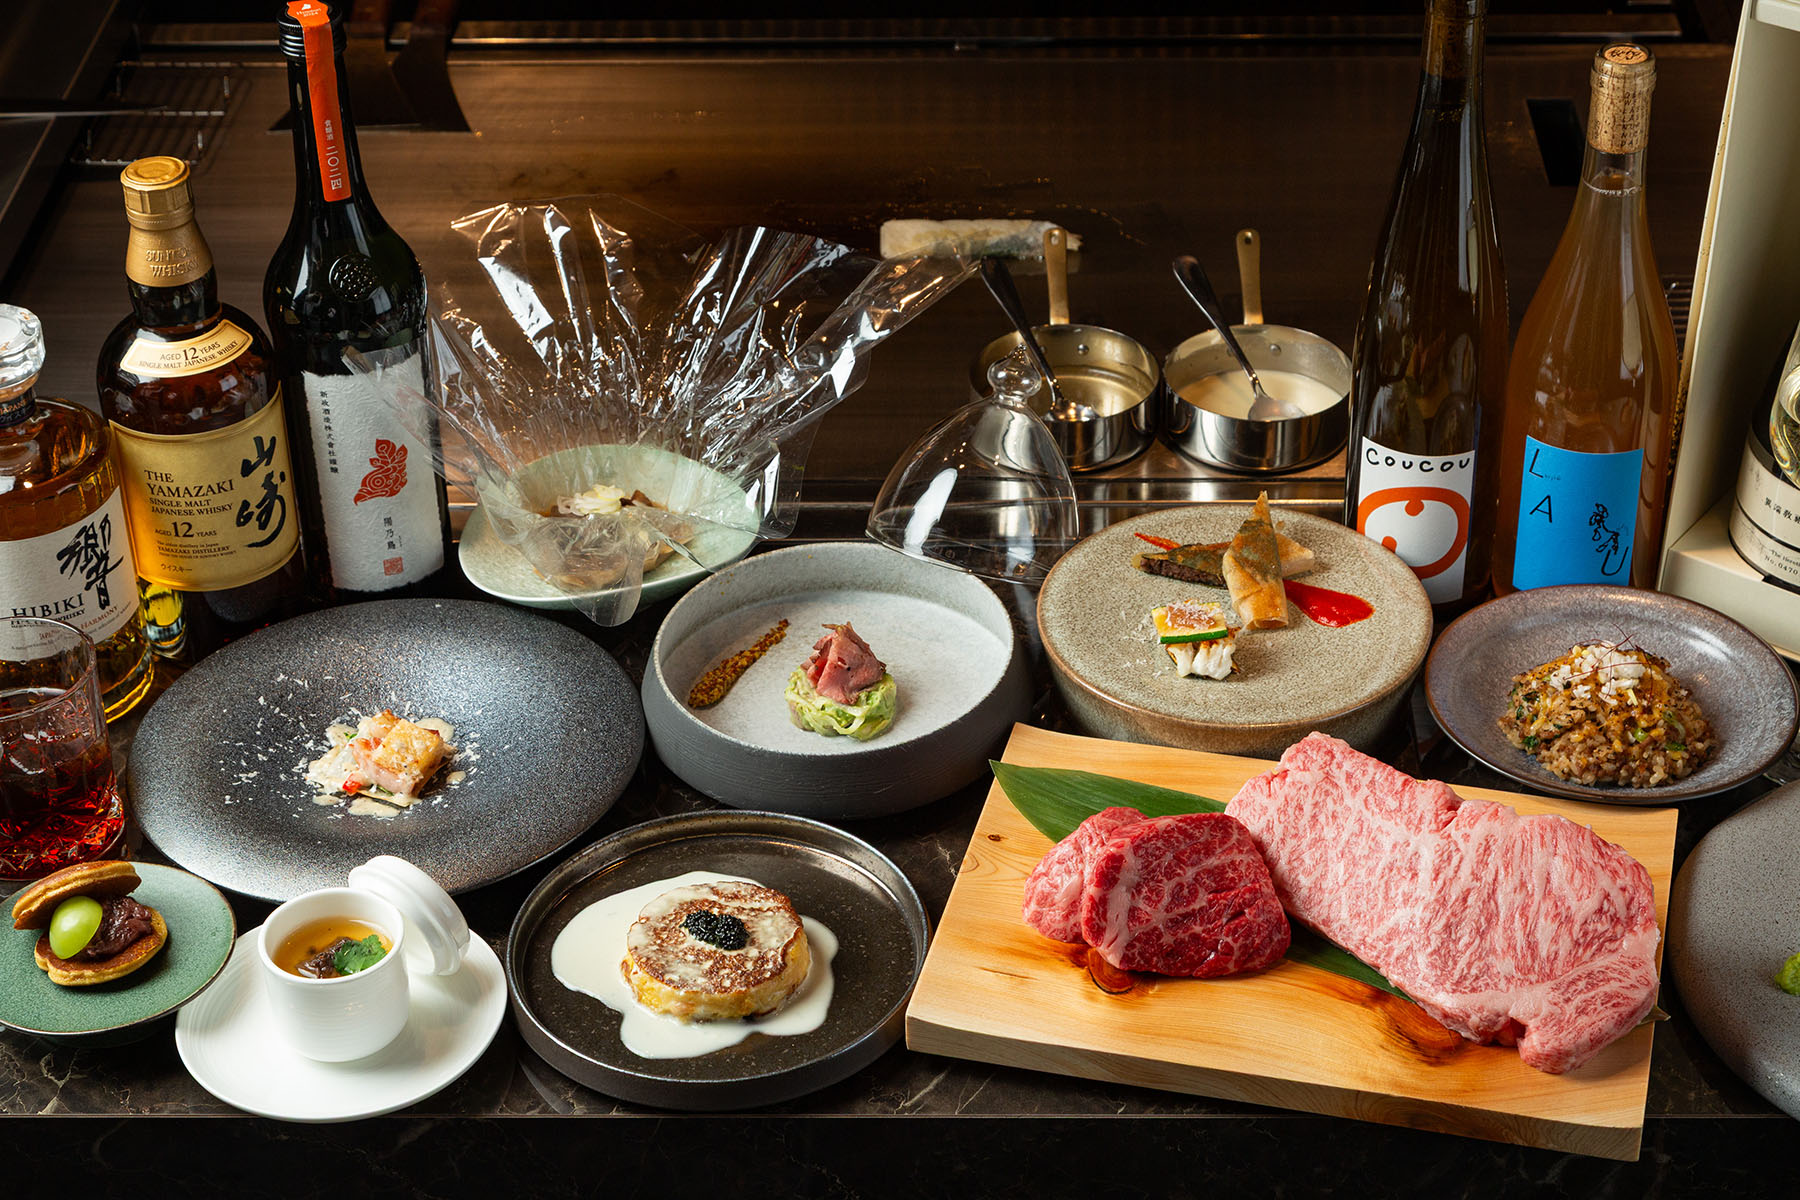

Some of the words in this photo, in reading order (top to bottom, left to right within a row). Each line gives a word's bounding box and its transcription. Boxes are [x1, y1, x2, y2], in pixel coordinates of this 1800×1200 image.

[182, 347, 199, 361] 12
[200, 342, 220, 355] YEARS
[184, 354, 217, 368] JAPANESE
[217, 340, 238, 356] WHISKY
[144, 470, 174, 483] THE
[147, 479, 235, 498] YAMAZAKI
[149, 498, 182, 508] SINGLE
[184, 499, 212, 507] MALT
[151, 506, 195, 516] JAPANESE
[196, 503, 233, 515] WHISKY
[155, 528, 171, 536] AGED
[172, 521, 194, 538] 12
[158, 546, 190, 554] YAMAZAKI
[11, 593, 85, 619] HIBIKI
[80, 606, 118, 630] HARMONY
